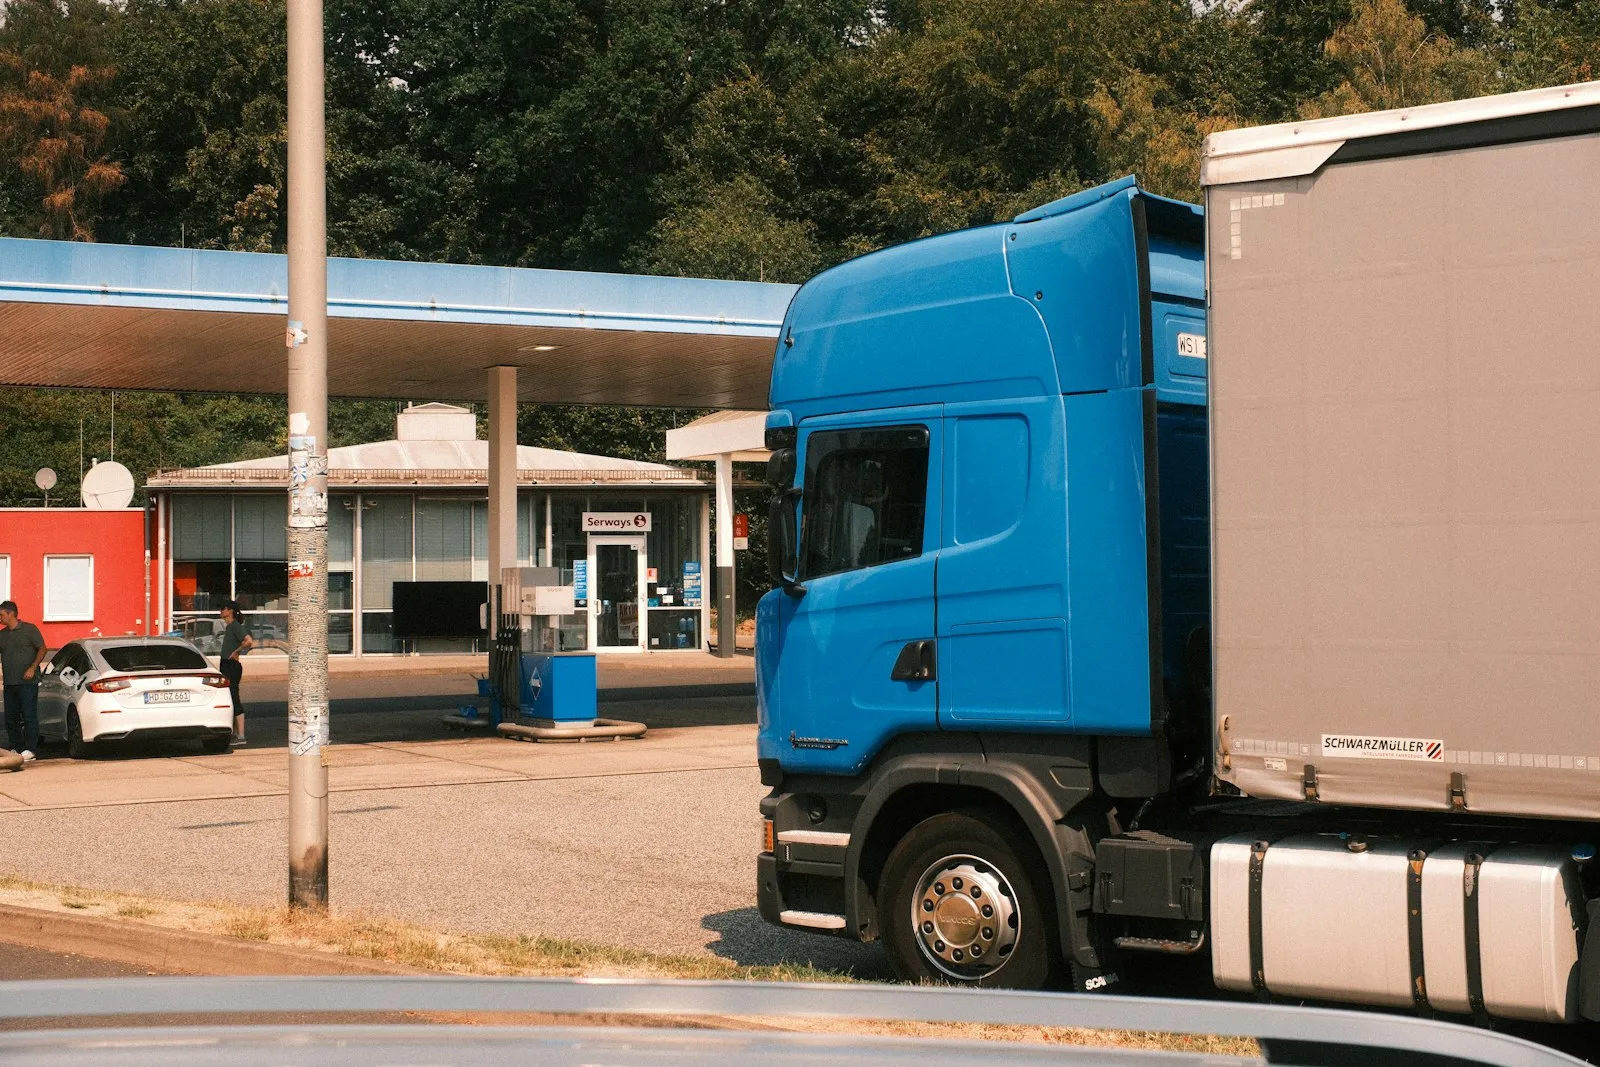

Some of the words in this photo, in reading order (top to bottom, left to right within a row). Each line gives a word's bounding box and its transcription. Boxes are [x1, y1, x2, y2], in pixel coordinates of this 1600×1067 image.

[587, 517, 631, 529] Serways
[149, 693, 159, 701] HD
[163, 692, 173, 701] GZ
[174, 691, 189, 700] 661
[1324, 737, 1424, 752] SCHWARZMÜLLER
